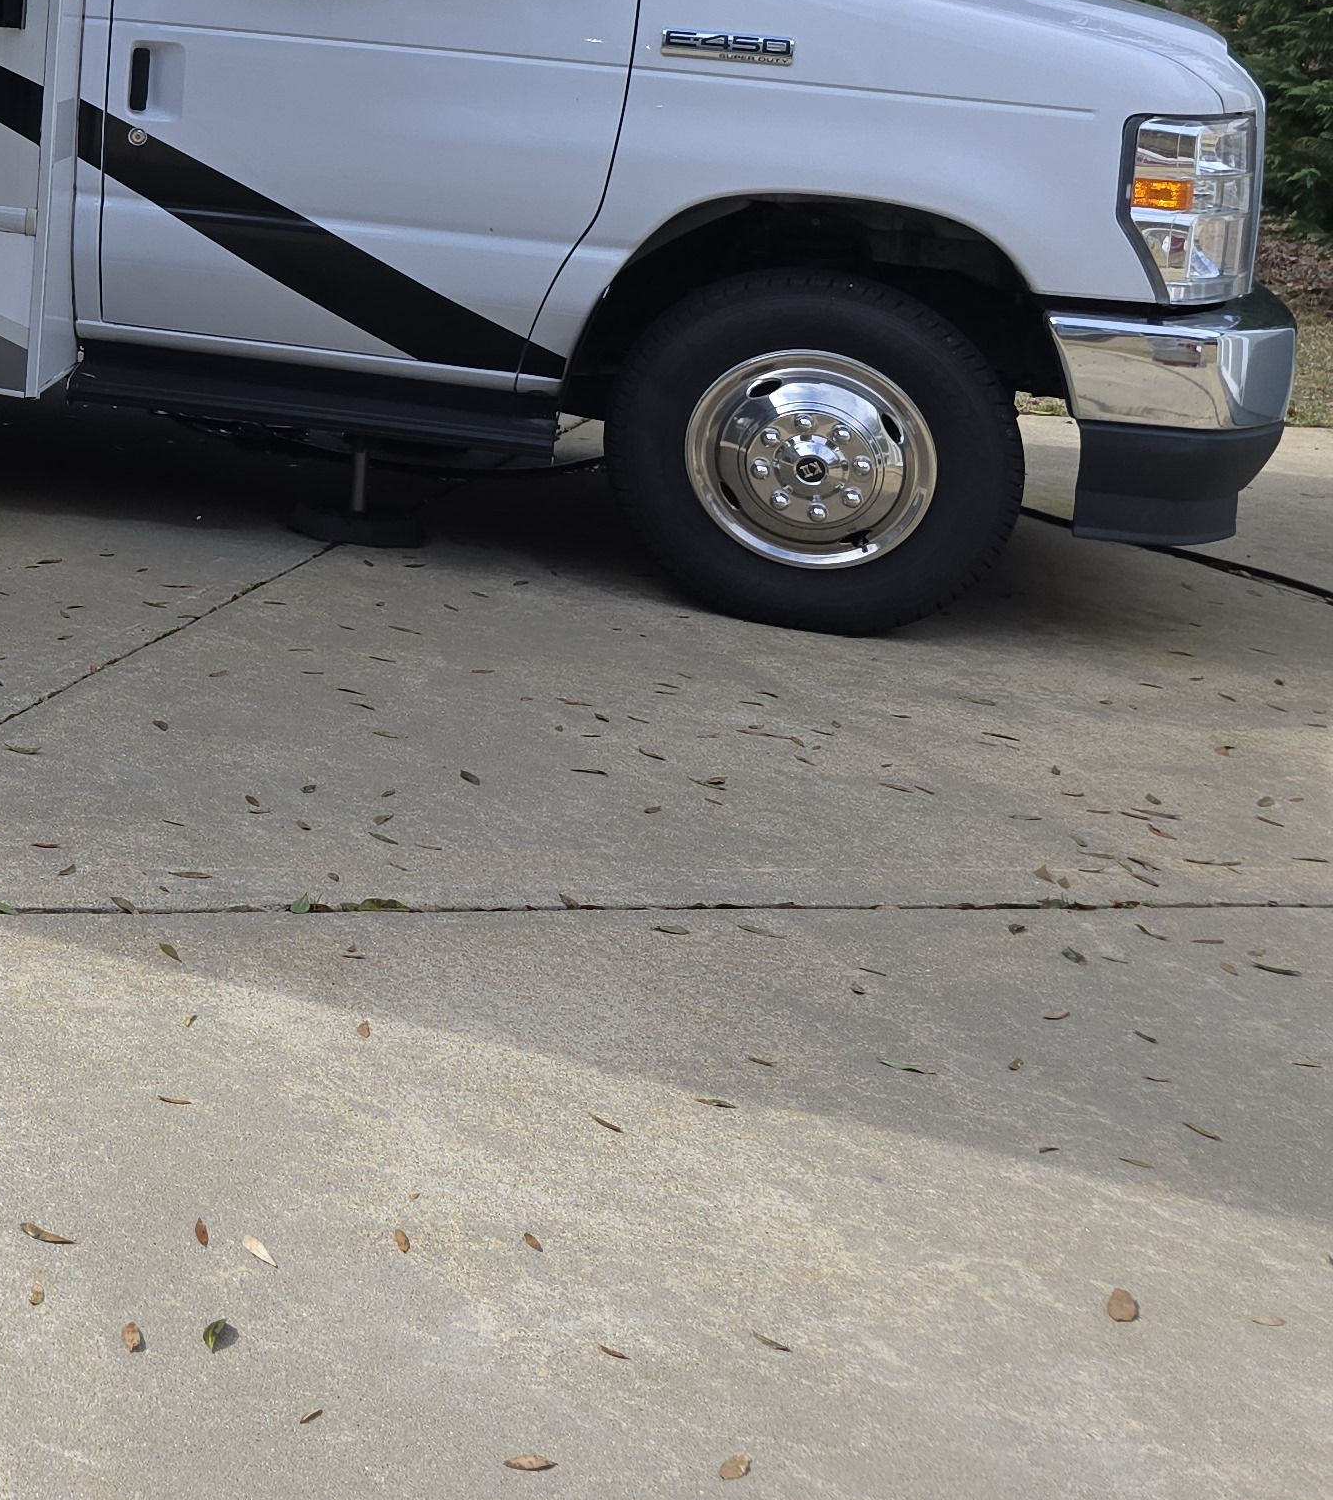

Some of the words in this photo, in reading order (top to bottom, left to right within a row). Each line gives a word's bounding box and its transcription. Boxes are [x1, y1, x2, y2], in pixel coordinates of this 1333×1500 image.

[665, 31, 791, 55] E-450
[718, 53, 755, 62] SUPER
[758, 56, 789, 64] DUTY
